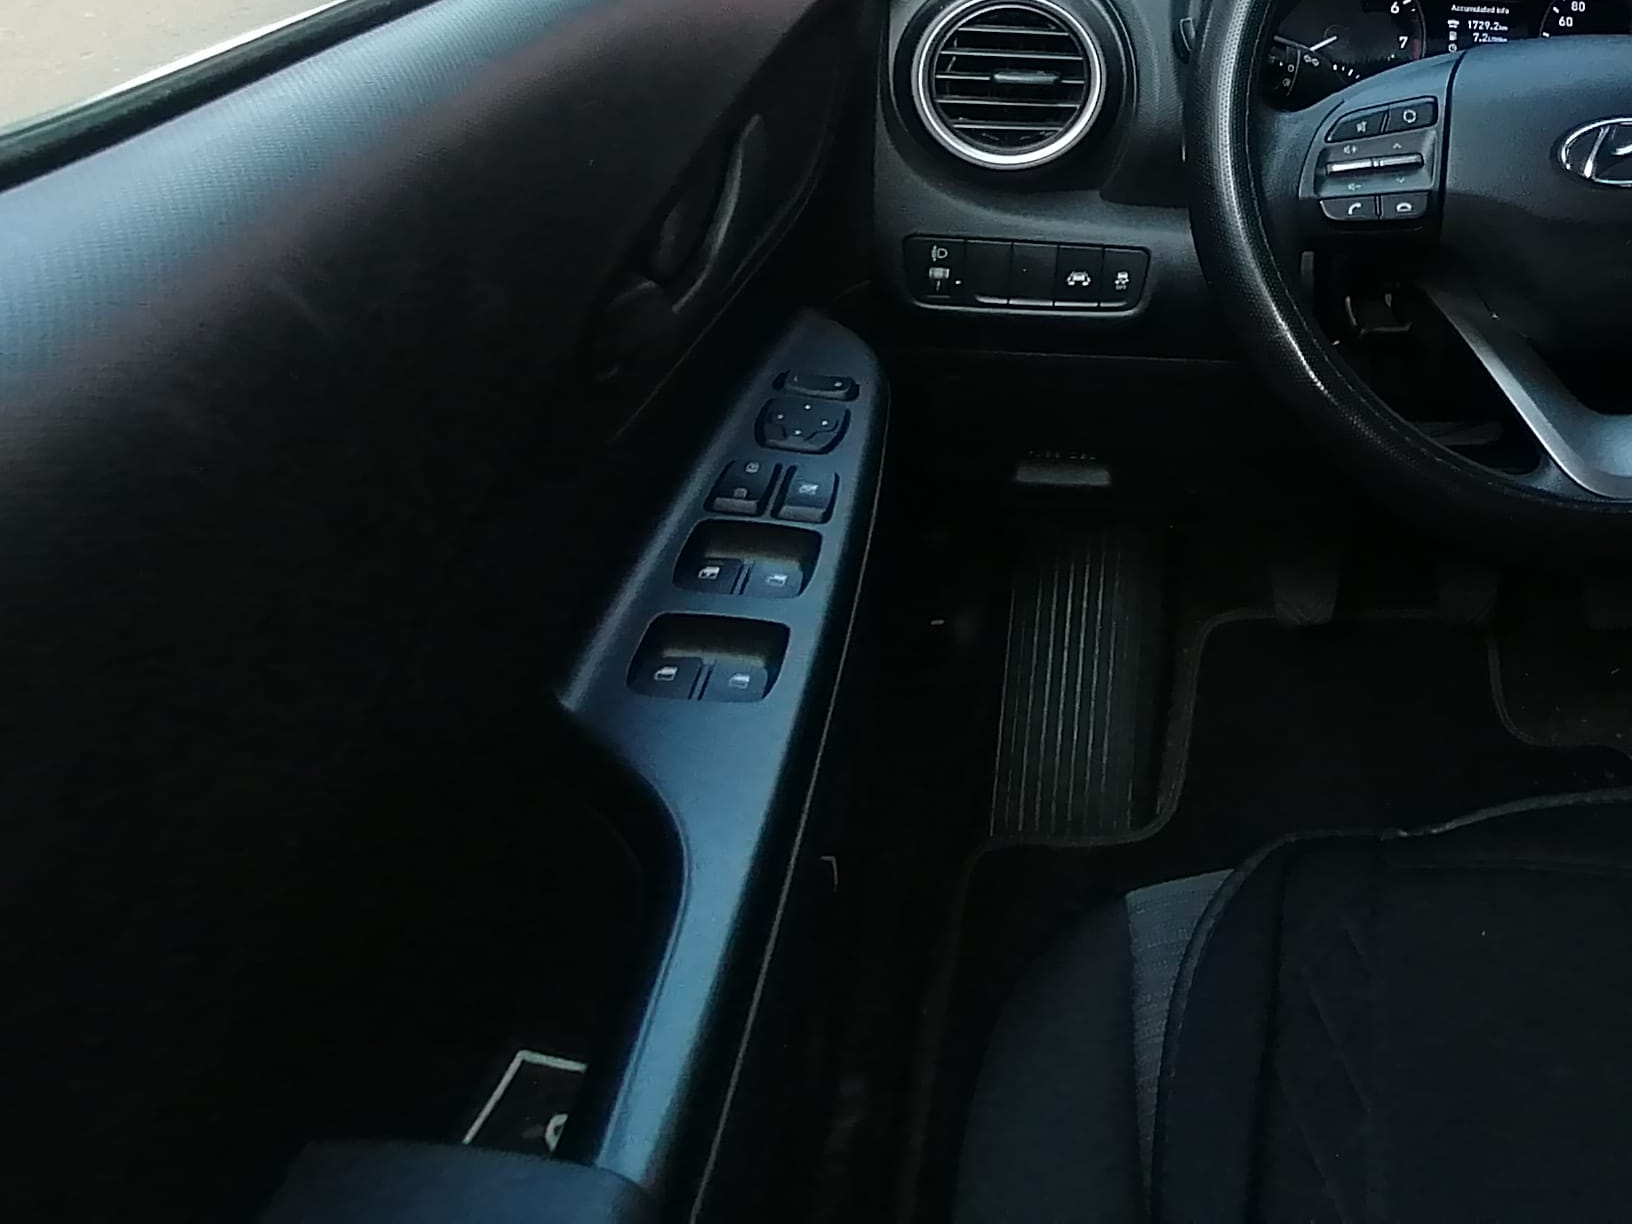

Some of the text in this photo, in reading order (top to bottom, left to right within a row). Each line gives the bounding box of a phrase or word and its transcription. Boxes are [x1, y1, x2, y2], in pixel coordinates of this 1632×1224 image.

[1390, 1, 1400, 14] 6
[1571, 1, 1586, 12] 80
[1558, 16, 1573, 27] 60
[1399, 36, 1408, 48] 7
